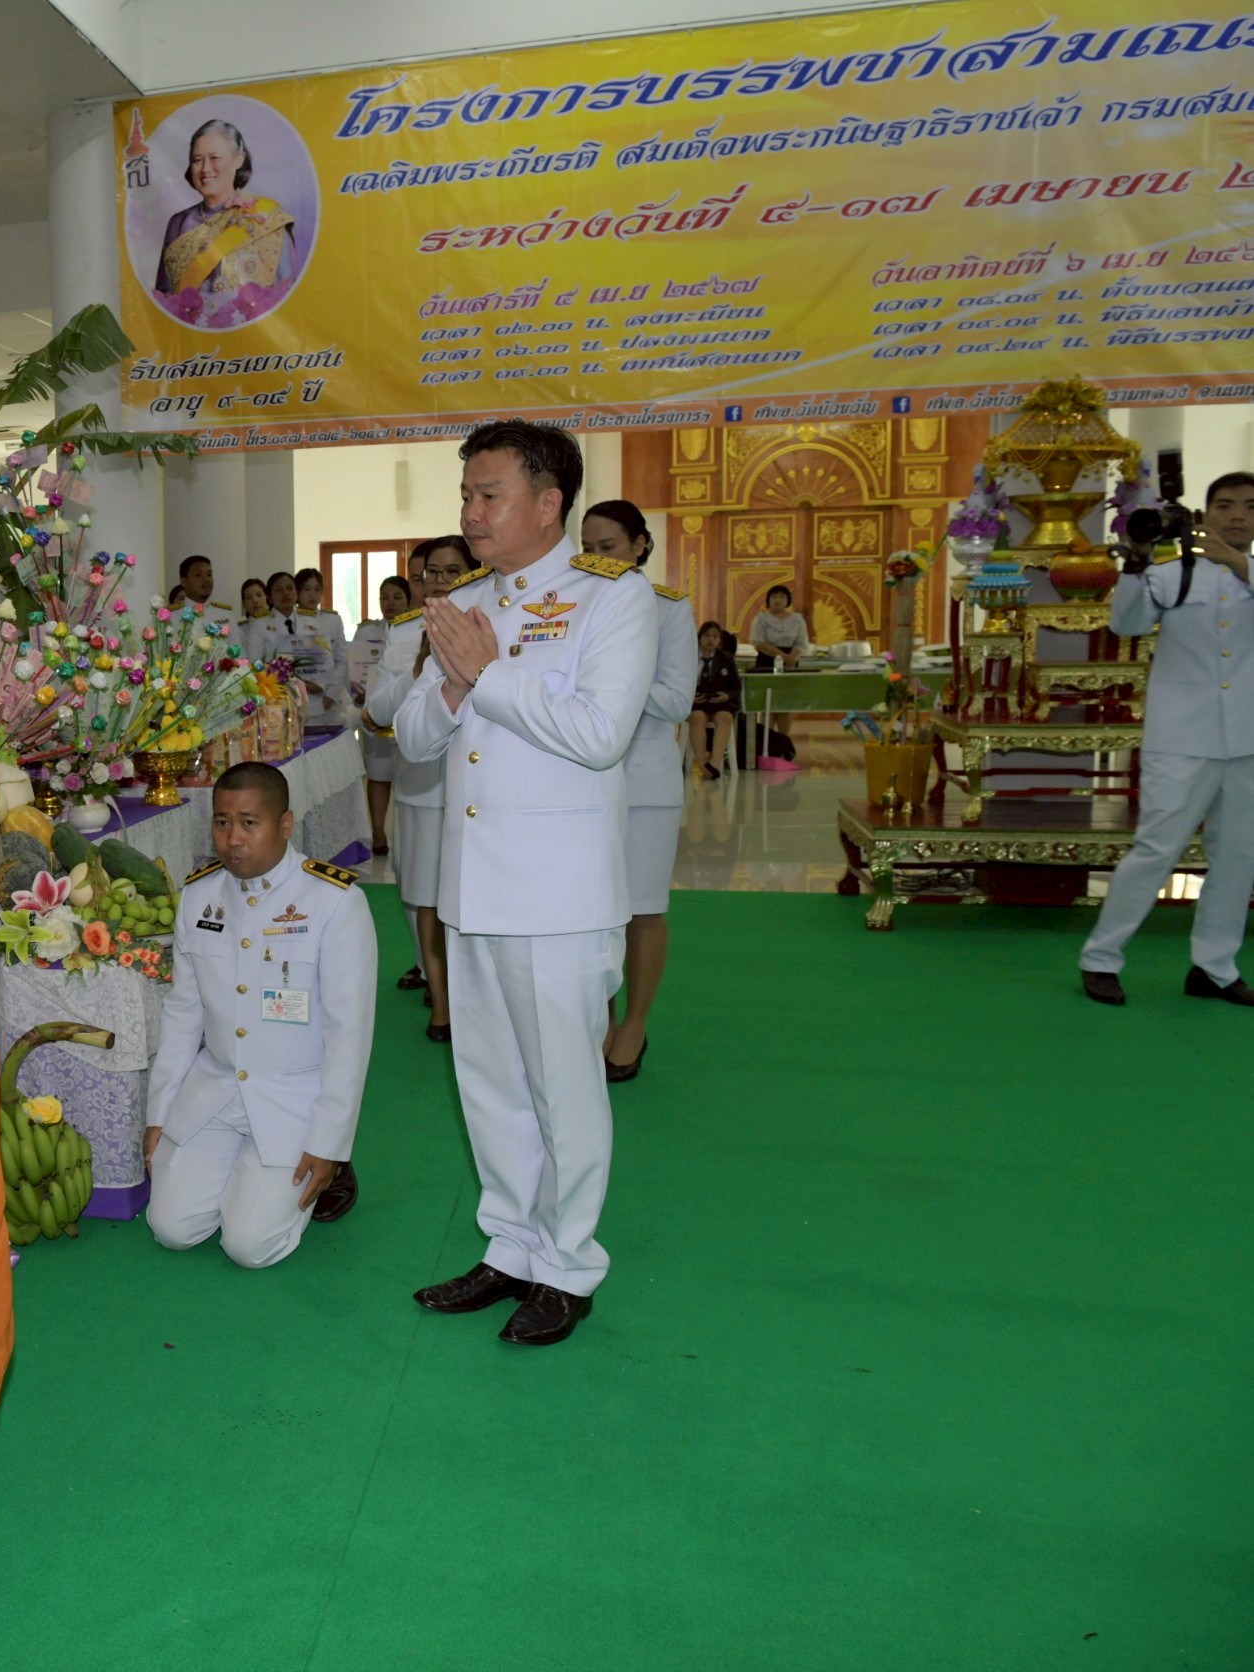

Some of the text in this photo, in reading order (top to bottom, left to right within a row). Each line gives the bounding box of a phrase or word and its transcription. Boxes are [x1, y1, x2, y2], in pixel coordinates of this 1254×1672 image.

[340, 141, 601, 195] เฉลิมพระเกียรติ
[616, 95, 1080, 180] สมเด็จพระกนิษฐาธิราชเจ้า
[420, 185, 749, 254] ระหว่างวันที่
[964, 169, 1194, 210] เมษายน
[872, 241, 1058, 288] วันอาทิตย์ที่
[419, 277, 548, 319] วันเสาร์ที่
[873, 297, 942, 313] เวลา
[420, 325, 482, 342] เวลา
[626, 304, 764, 329] ลงทะเบียน
[873, 320, 942, 337] เวลา
[130, 345, 344, 382] รับสมัครเยาวชน
[420, 347, 482, 364] เวลา
[620, 328, 772, 352] ปลงผมนาค
[872, 342, 942, 359] เวลา
[420, 368, 483, 385] เวลา
[150, 394, 204, 418] อายุ
[302, 379, 325, 402] ปี
